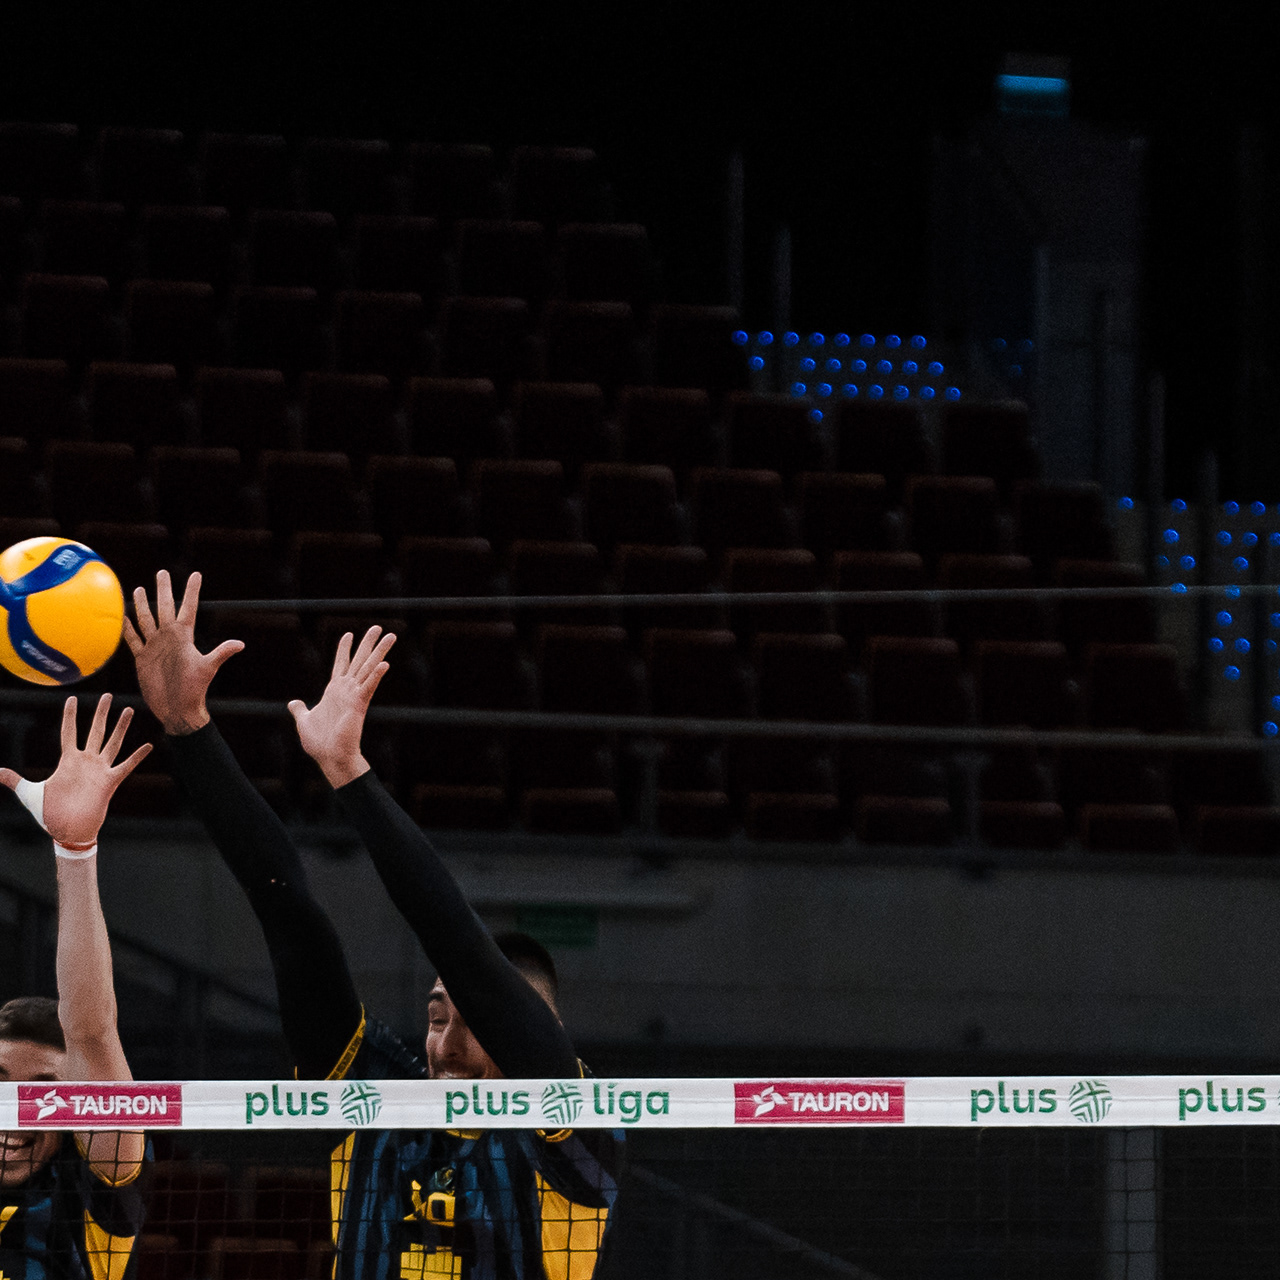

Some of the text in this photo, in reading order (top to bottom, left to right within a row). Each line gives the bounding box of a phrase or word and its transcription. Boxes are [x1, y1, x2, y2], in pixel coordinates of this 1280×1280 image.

[70, 1095, 167, 1115] TAURON
[245, 1084, 330, 1124] plus
[445, 1083, 670, 1123] plus liga
[788, 1091, 889, 1111] TAURON
[970, 1081, 1057, 1122] plus
[1179, 1080, 1266, 1121] plus
